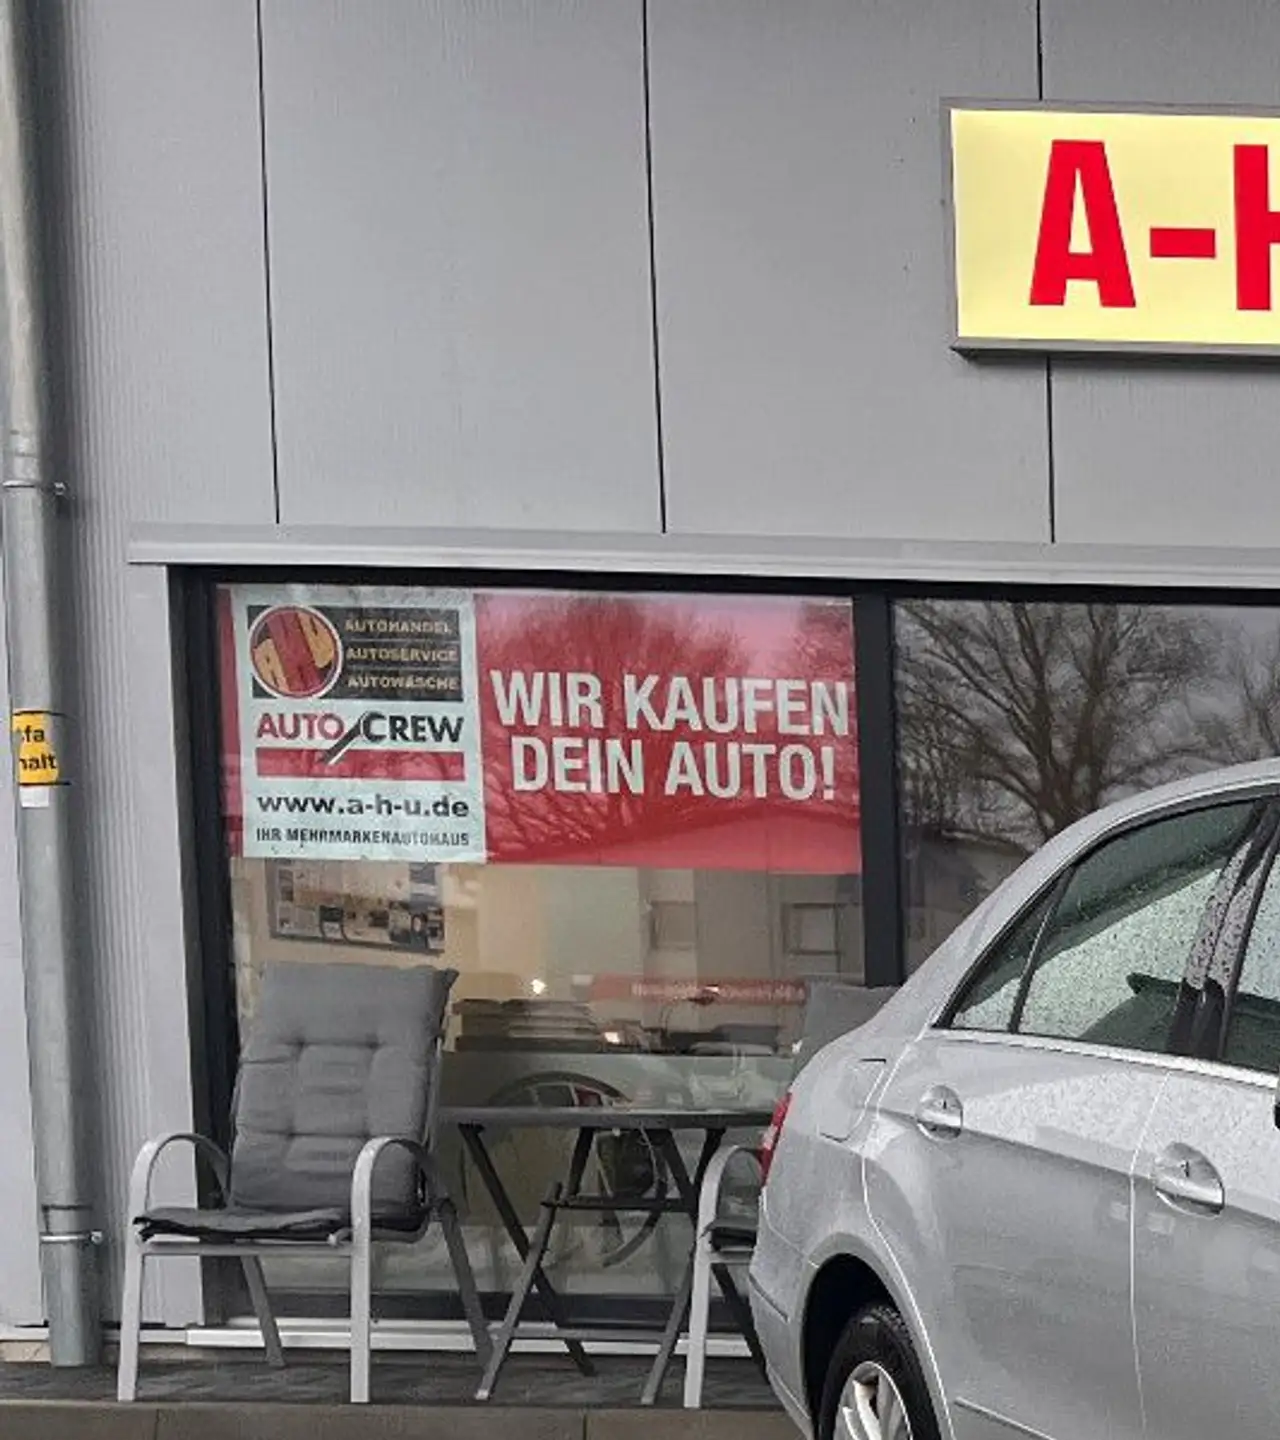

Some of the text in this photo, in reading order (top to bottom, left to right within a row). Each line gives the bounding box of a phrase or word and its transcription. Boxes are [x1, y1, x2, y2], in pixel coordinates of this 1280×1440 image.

[345, 619, 450, 633] AUTOHANDEL
[346, 647, 459, 662] AUTOSERVICE
[490, 669, 849, 736] WIR KAUFEN
[22, 725, 45, 743] fa
[256, 711, 465, 744] AUTO CREW
[510, 735, 835, 801] DEIN AUTO!
[256, 794, 470, 818] www.a-h-u.de
[256, 827, 470, 847] IHR MEHRMARKENAUTOHAUS
